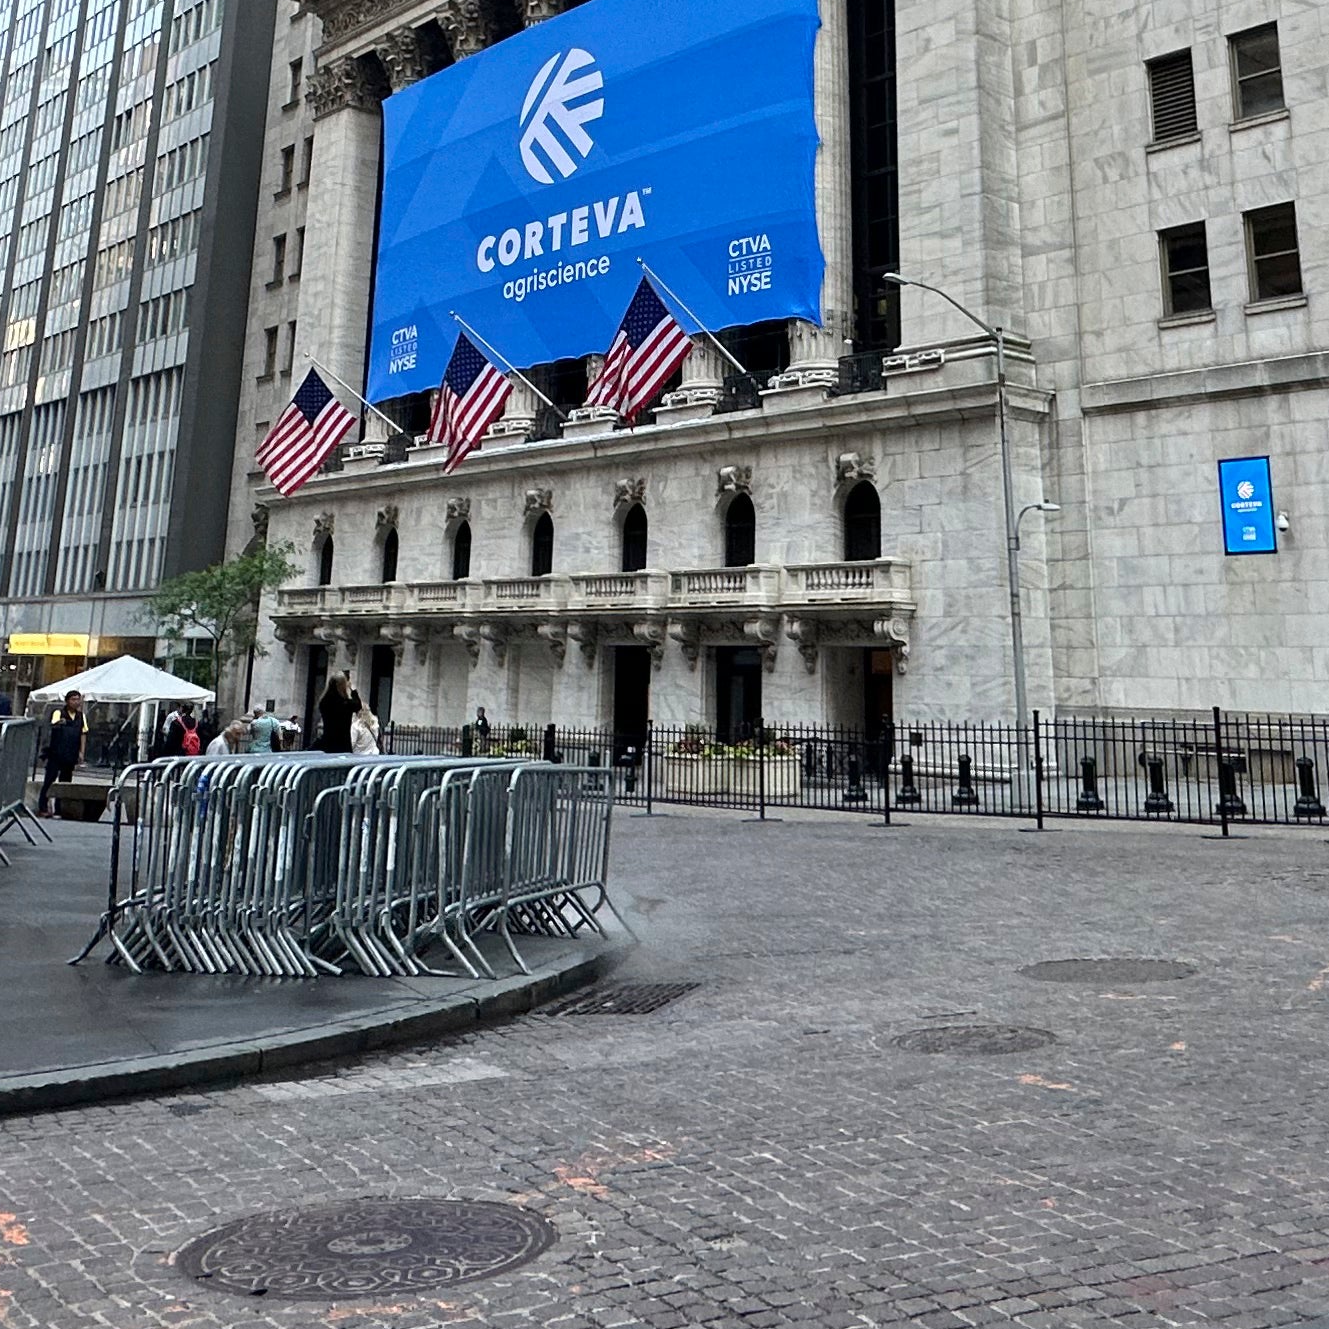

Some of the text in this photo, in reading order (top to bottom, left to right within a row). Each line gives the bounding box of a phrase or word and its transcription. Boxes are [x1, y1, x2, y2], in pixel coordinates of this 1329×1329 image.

[476, 191, 646, 273] CORTEVA
[728, 233, 771, 258] CTVA
[728, 255, 772, 274] LISTED
[503, 255, 611, 302] agriscience
[728, 271, 772, 297] NYSE
[392, 324, 418, 345] CTVA
[390, 341, 418, 357] LISTED
[388, 353, 417, 375] NYSE
